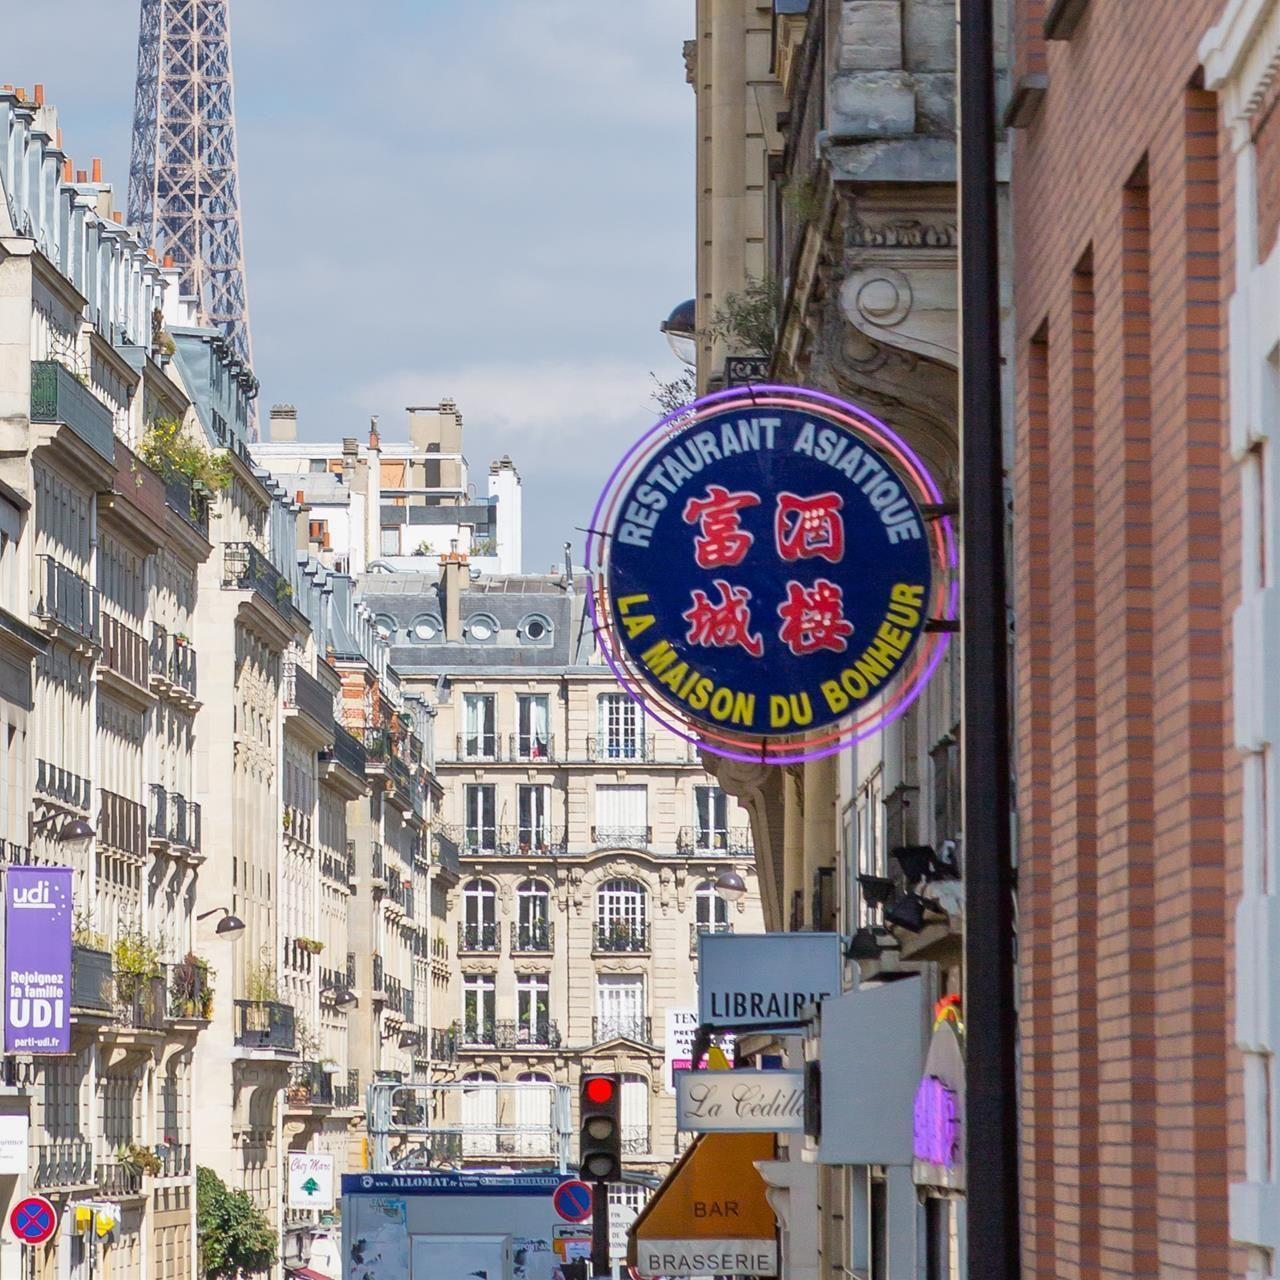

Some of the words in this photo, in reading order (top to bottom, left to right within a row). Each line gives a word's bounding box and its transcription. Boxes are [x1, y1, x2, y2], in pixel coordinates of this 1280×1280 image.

[618, 418, 781, 548] RESTAURANT
[794, 423, 921, 544] ASIATIQUE
[617, 593, 656, 639] LA
[641, 640, 755, 727] MAISON
[771, 692, 812, 728] DU
[821, 583, 924, 714] BONHEUR
[13, 880, 49, 903] udi
[11, 971, 64, 985] Rejoignez
[11, 985, 22, 998] la
[25, 985, 64, 998] famille
[10, 999, 64, 1029] UDI
[15, 1037, 59, 1048] parti-udi.fr
[684, 1083, 723, 1119] La
[694, 1201, 739, 1219] BAR
[648, 1253, 770, 1272] BRASSERIE
